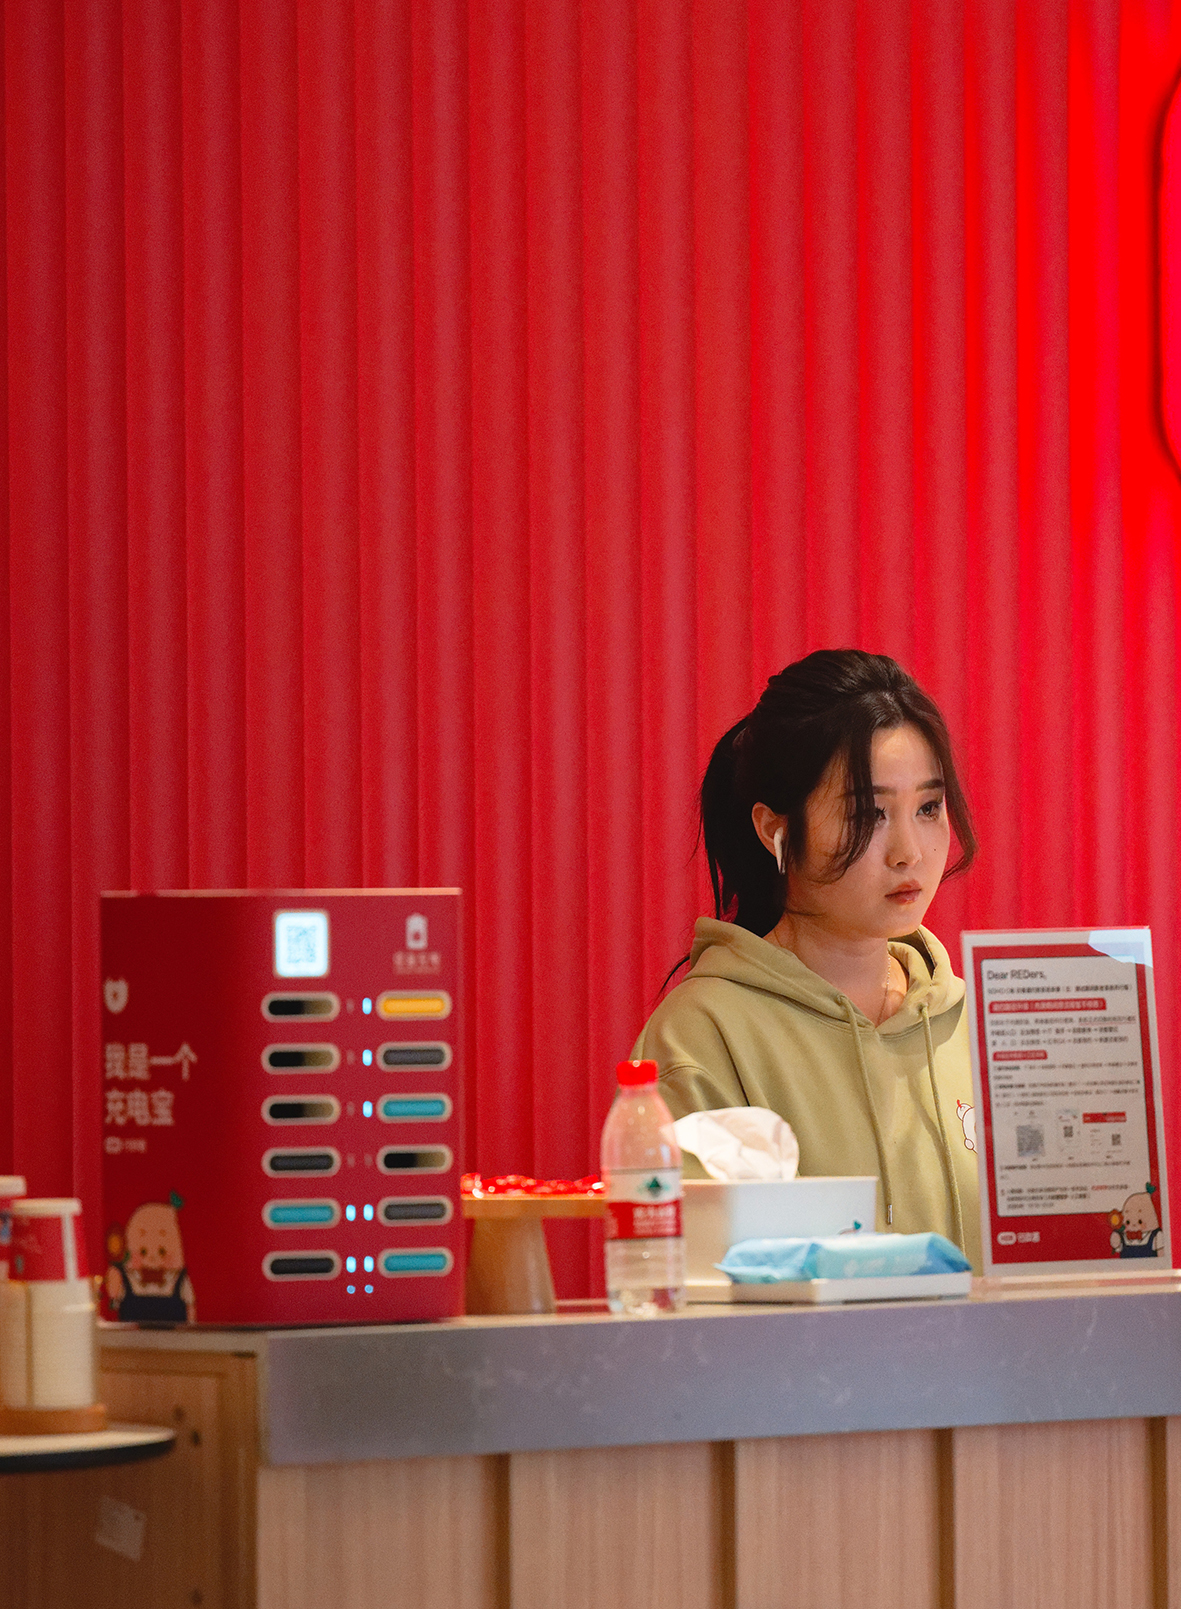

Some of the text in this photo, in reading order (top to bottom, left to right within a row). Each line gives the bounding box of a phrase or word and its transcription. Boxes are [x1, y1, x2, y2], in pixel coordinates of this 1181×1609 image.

[987, 970, 1008, 980] Dear
[105, 1043, 198, 1080] 我是一个
[105, 1089, 174, 1126] 充电宝
